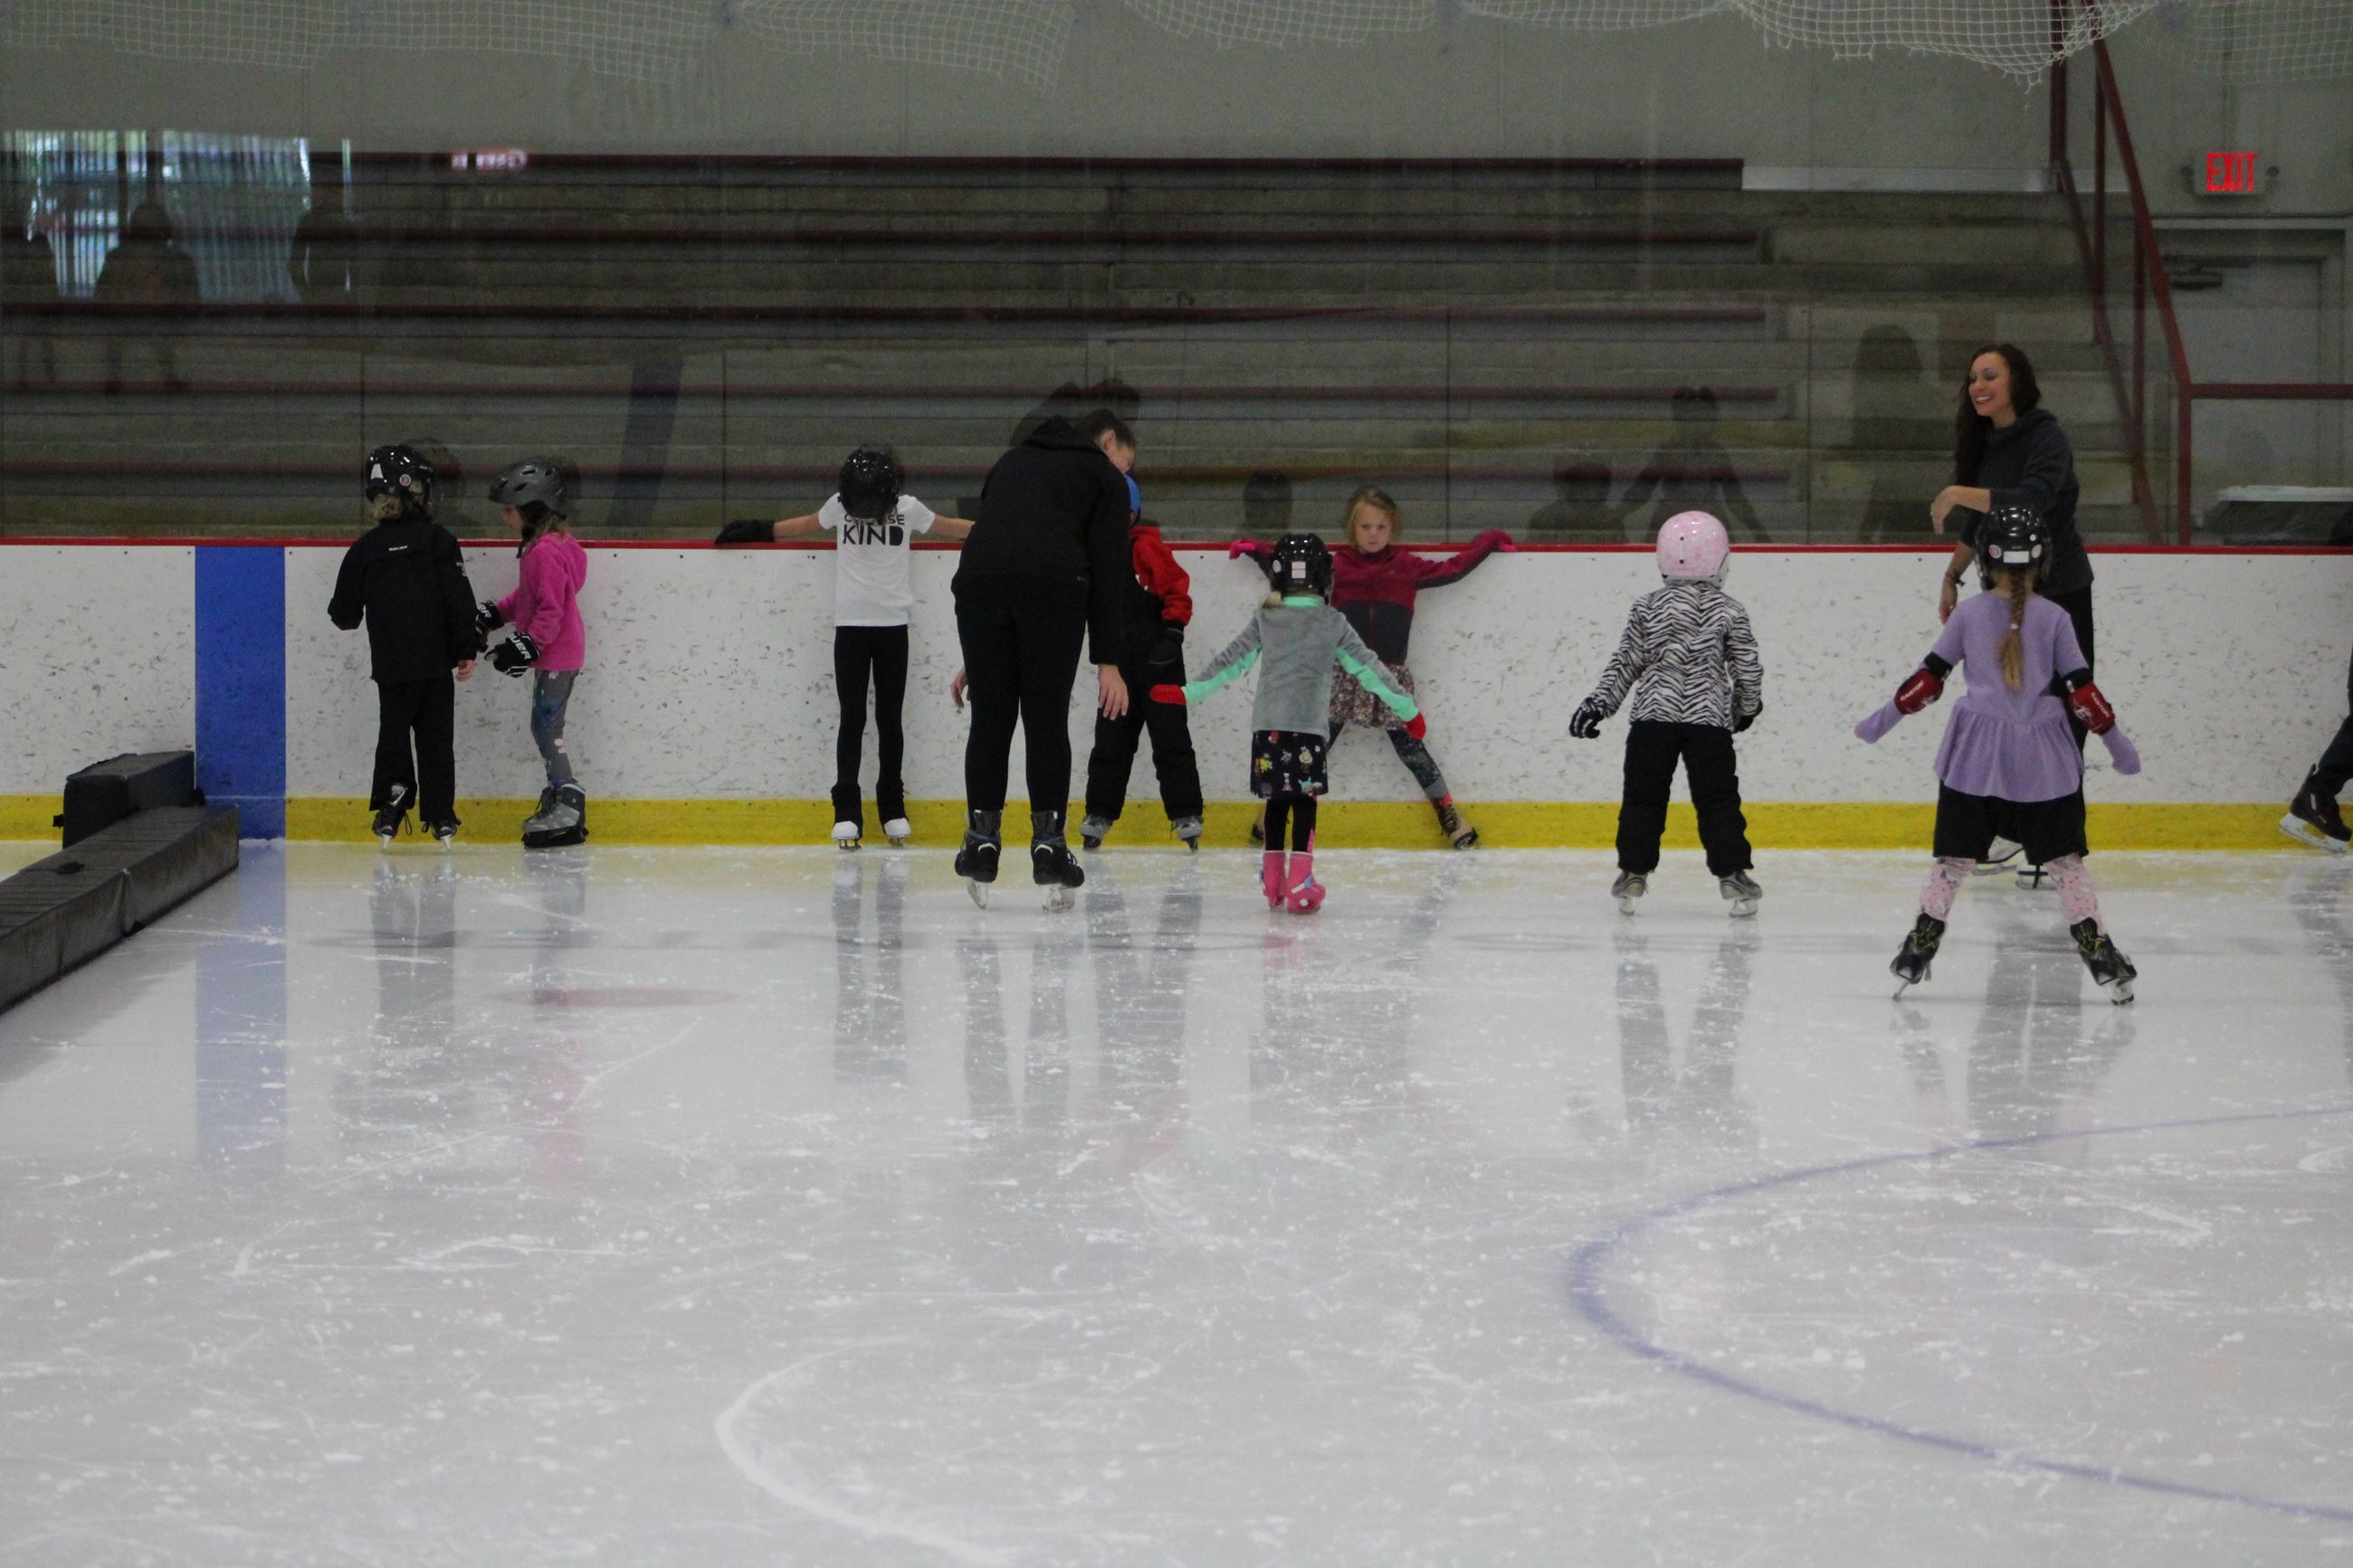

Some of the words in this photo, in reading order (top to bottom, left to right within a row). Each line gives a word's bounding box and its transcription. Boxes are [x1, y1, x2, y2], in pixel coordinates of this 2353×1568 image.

[2205, 151, 2259, 192] EXIT
[843, 513, 905, 526] CSE
[843, 524, 904, 546] KIND
